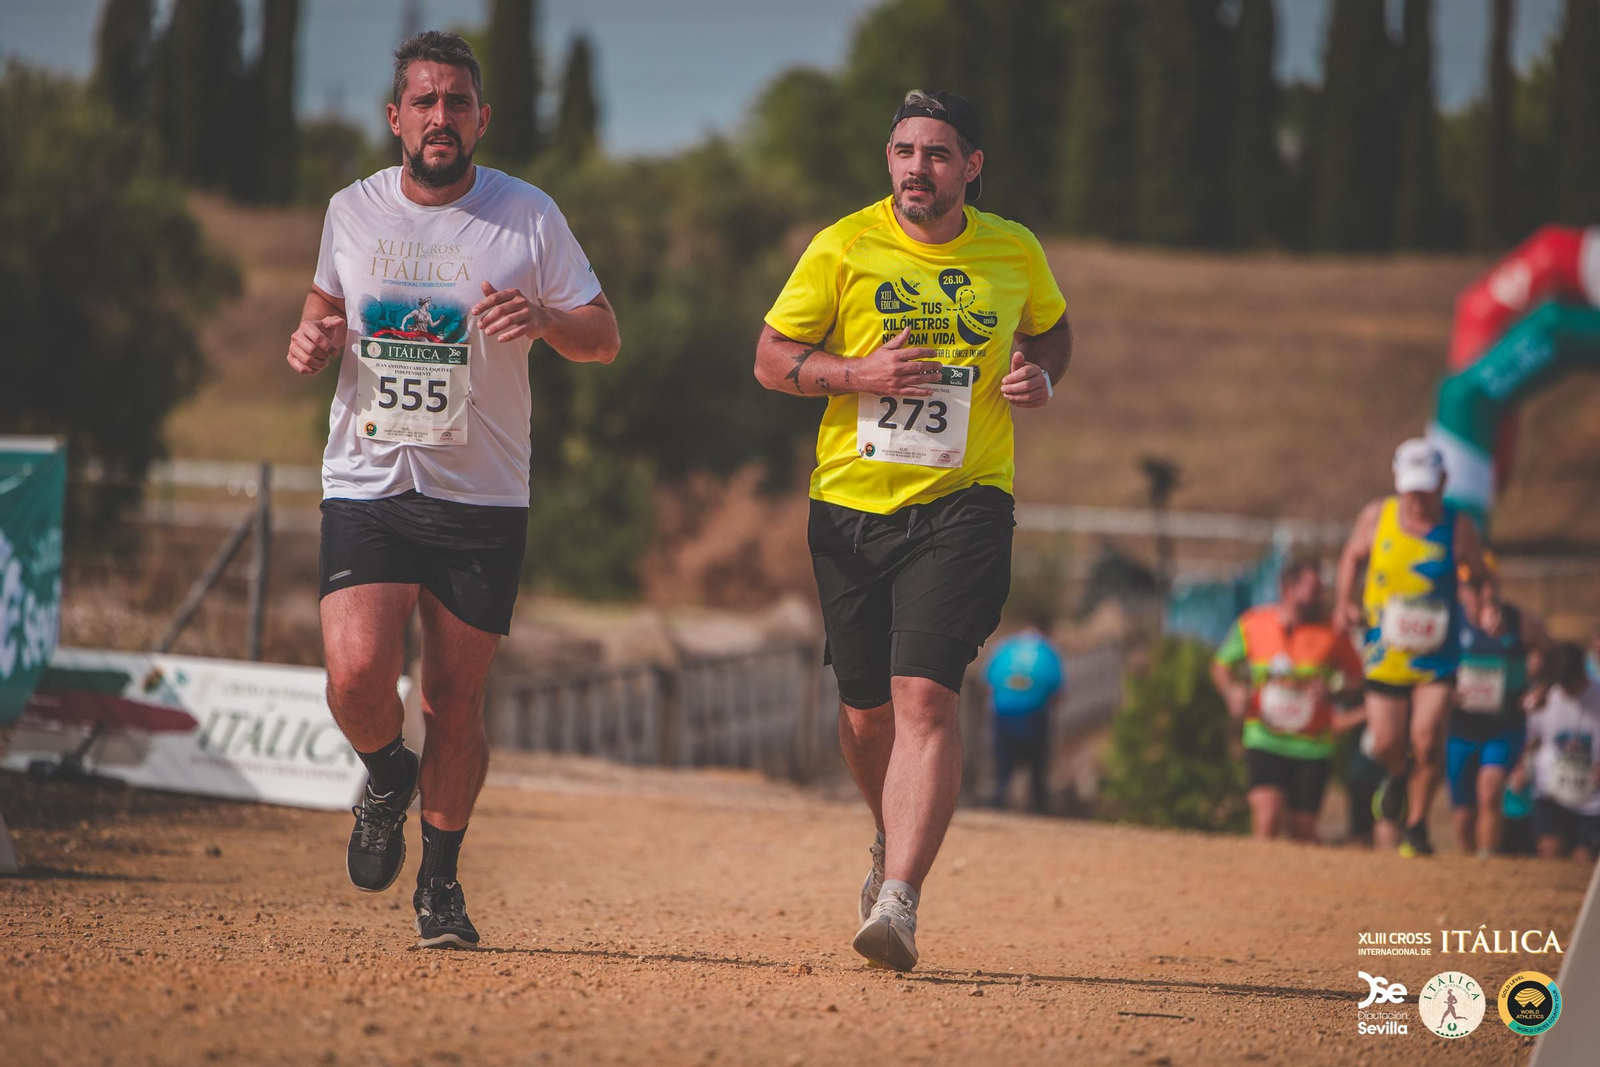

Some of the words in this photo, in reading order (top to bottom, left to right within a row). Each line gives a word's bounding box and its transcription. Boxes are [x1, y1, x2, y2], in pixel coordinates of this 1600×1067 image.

[375, 239, 420, 257] XLIII
[421, 244, 460, 254] CROSS
[371, 256, 470, 281] ITÁLICA
[382, 279, 419, 287] INTERNATIONAL
[943, 275, 964, 285] 26.10
[881, 291, 892, 300] XIII
[881, 299, 900, 310] EDICIÓN
[921, 302, 942, 314] TUS
[883, 315, 950, 331] KILÓMETROS
[908, 333, 928, 345] DAN
[933, 333, 955, 344] VIDA
[388, 345, 440, 360] ITÁLICA
[379, 376, 448, 413] 555
[878, 396, 947, 433] 273
